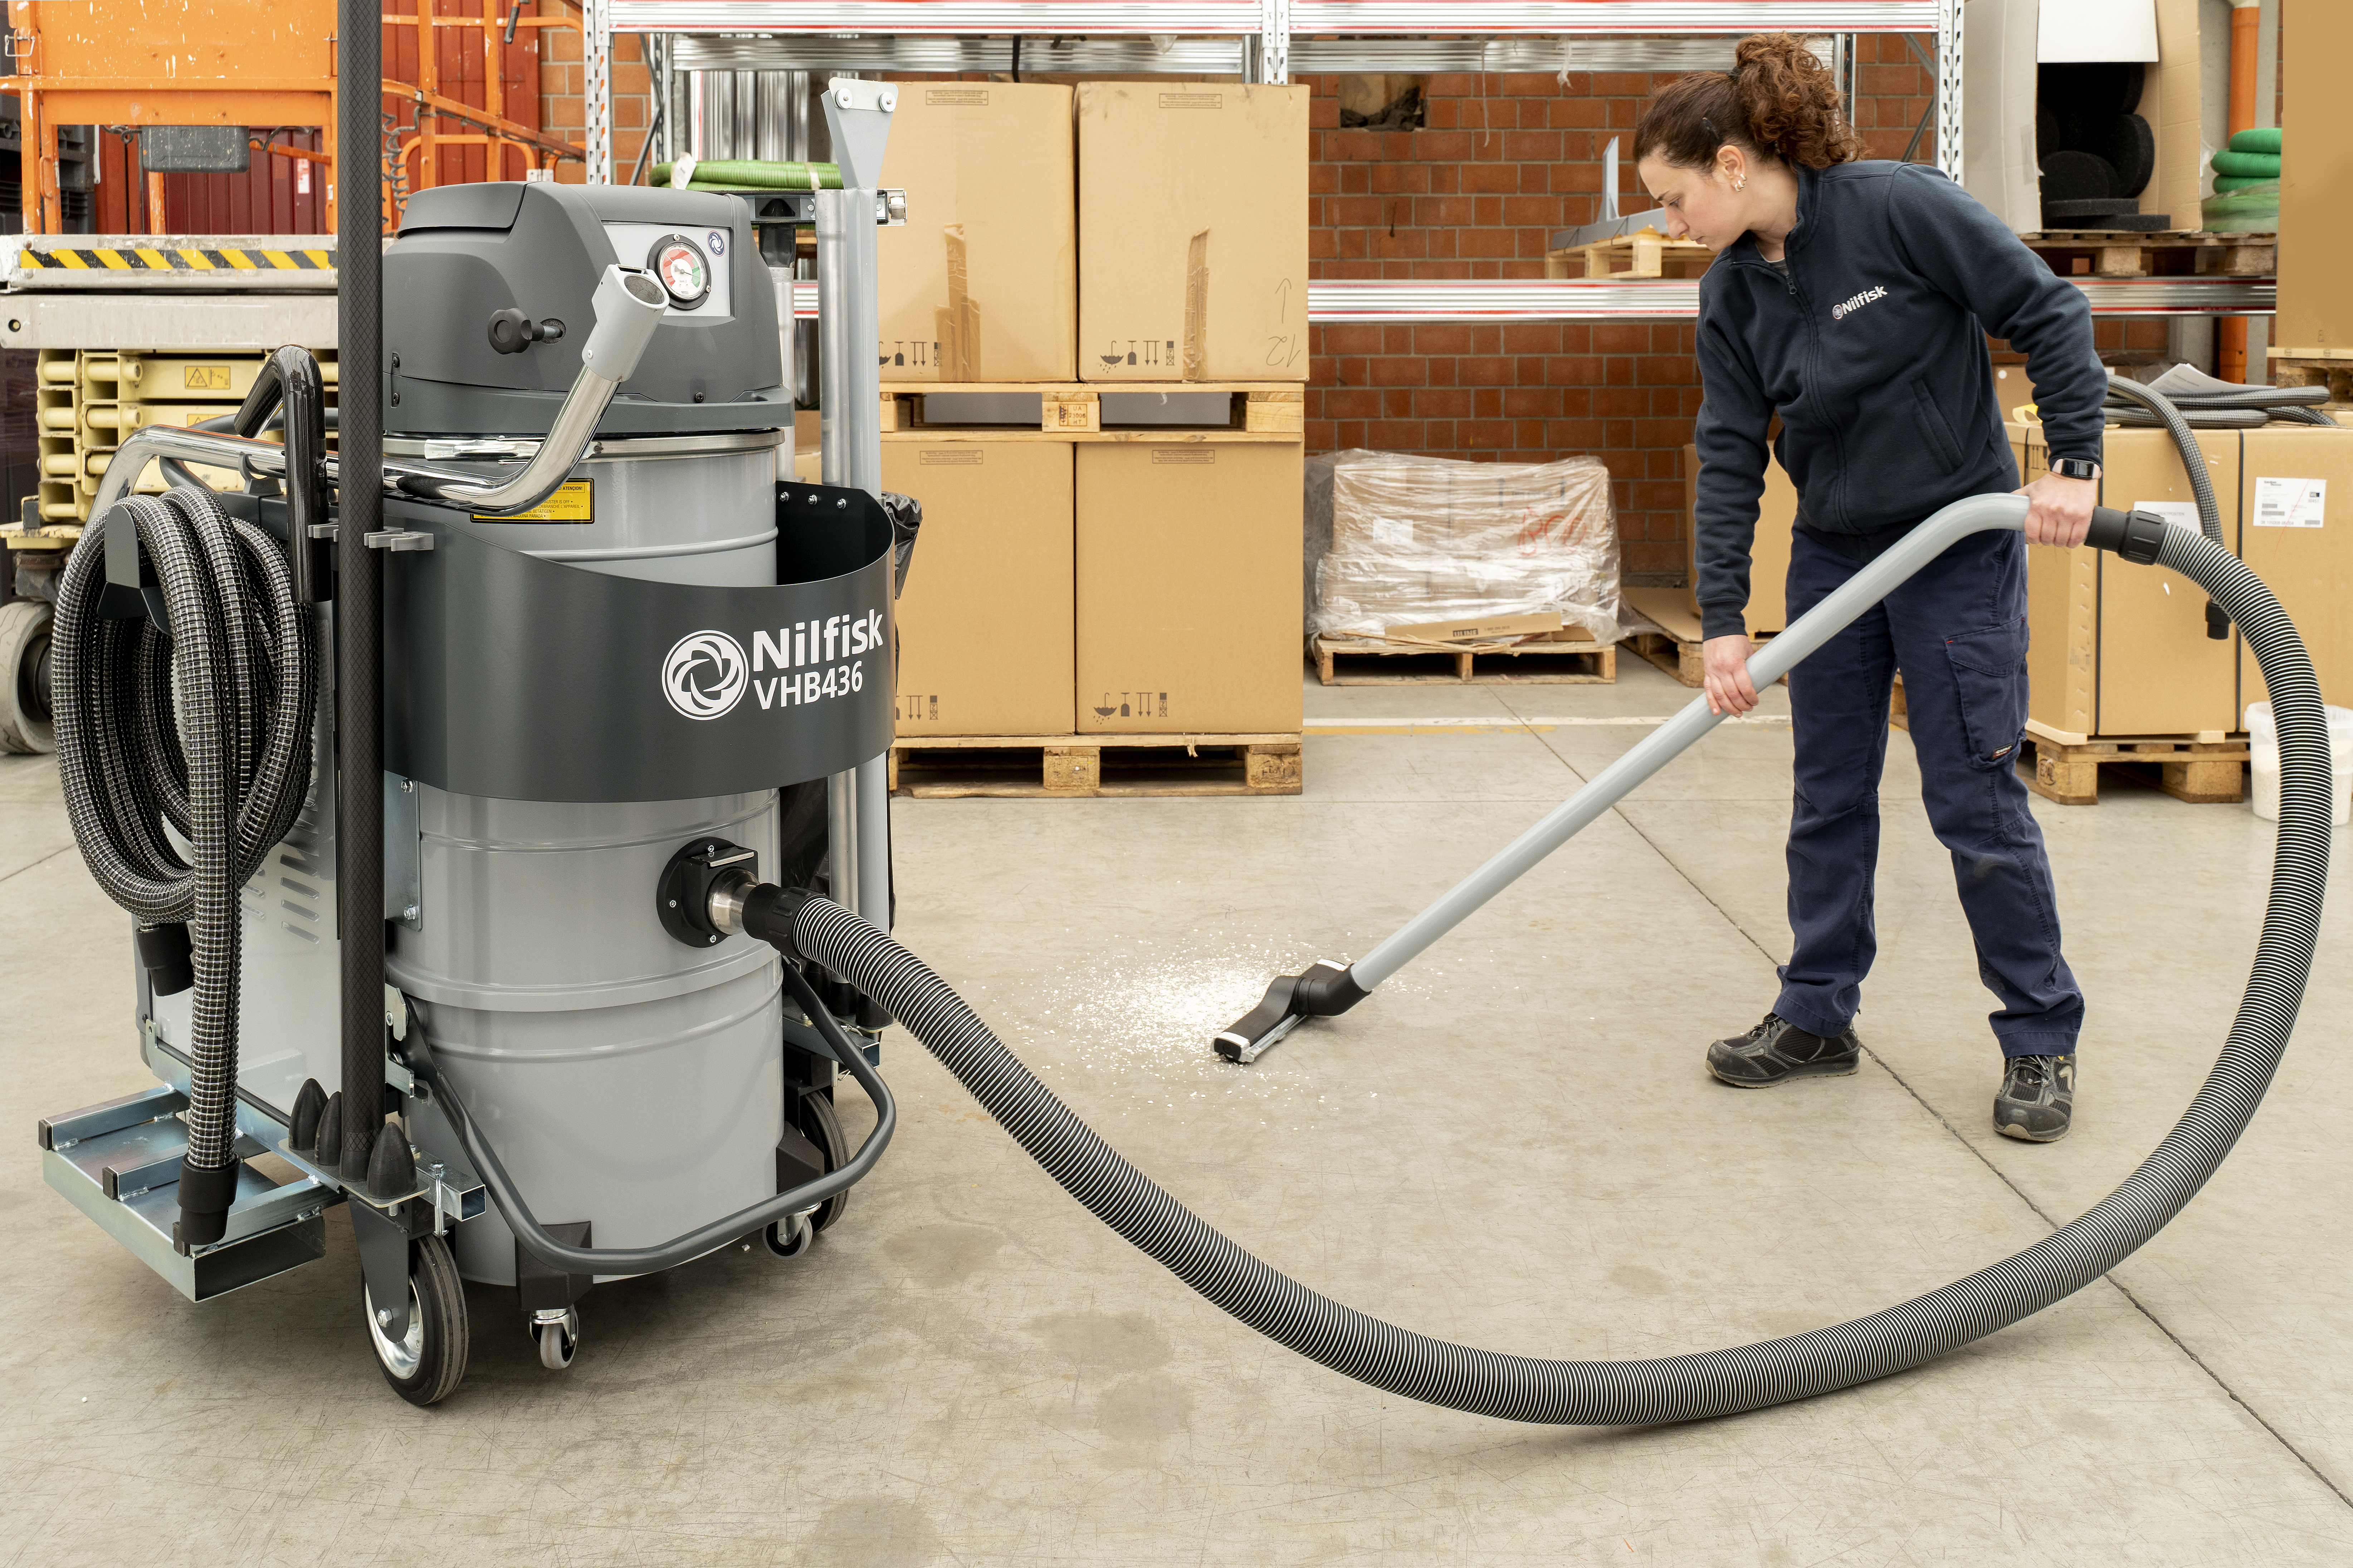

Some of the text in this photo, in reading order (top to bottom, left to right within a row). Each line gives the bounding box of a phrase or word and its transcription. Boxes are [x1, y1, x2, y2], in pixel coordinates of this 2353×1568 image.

[1841, 286, 1888, 314] Nilfisk
[753, 609, 883, 671] Nilfisk
[753, 661, 863, 710] VHB436
